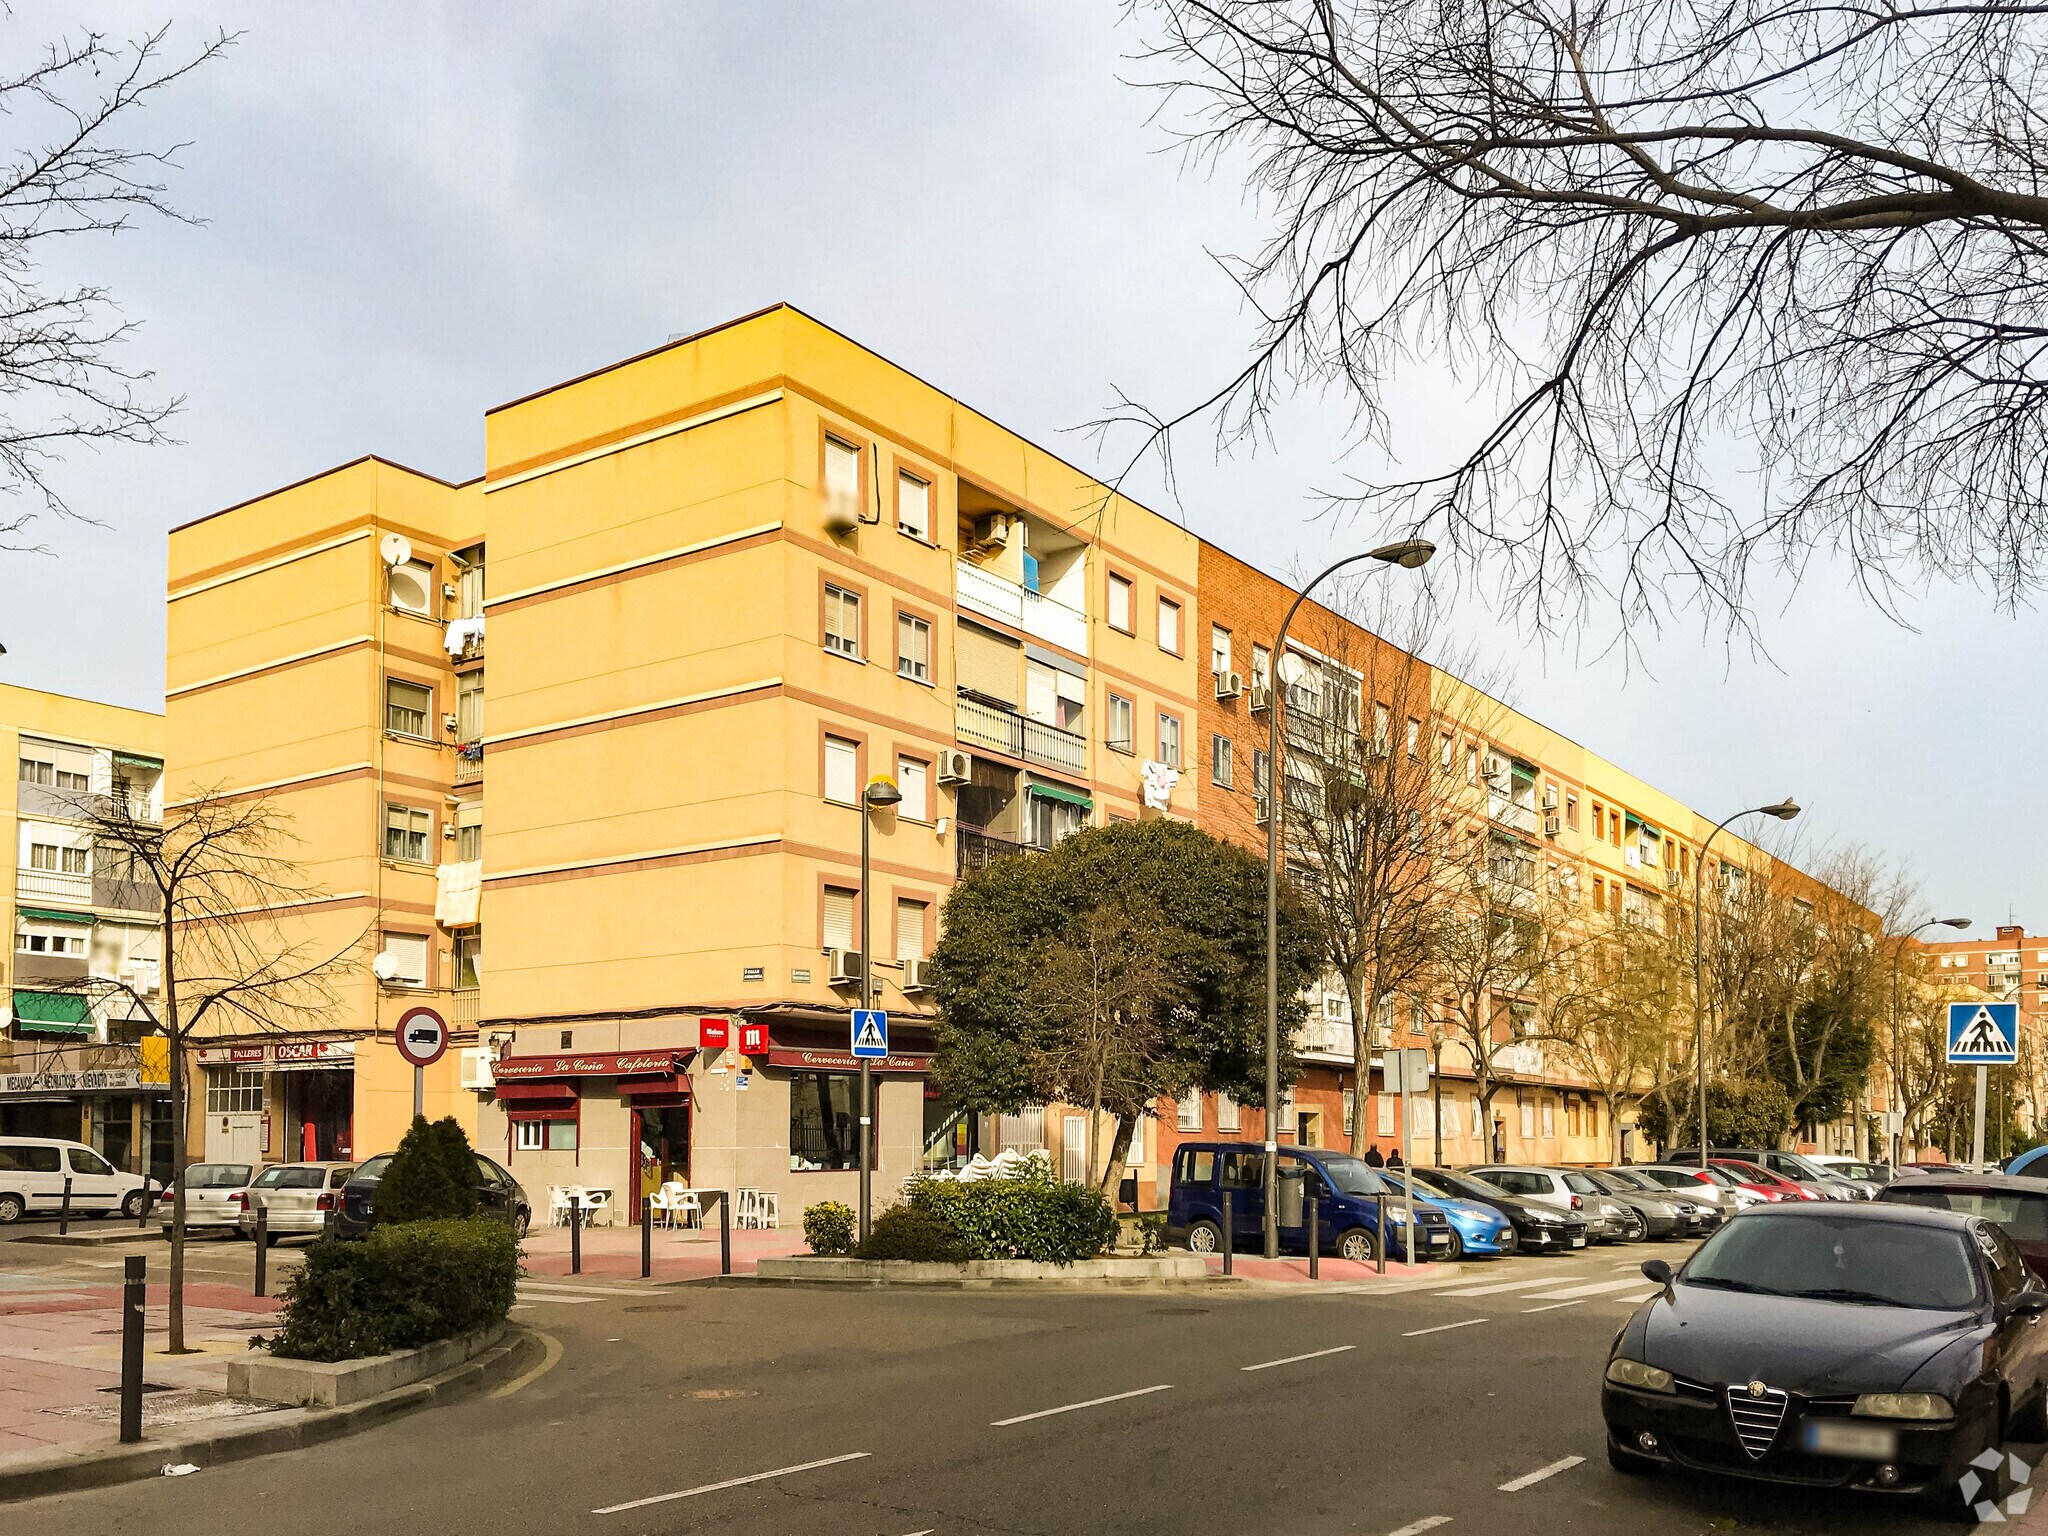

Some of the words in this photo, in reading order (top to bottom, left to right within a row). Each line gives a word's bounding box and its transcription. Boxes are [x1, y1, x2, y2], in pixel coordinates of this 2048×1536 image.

[233, 1049, 262, 1058] TALLERES
[278, 1045, 313, 1058] OSCAR
[491, 1062, 544, 1074] Cervecería
[553, 1060, 571, 1072] La
[572, 1061, 606, 1071] Caña
[616, 1057, 671, 1074] Cafetería
[801, 1052, 859, 1067] Cervecería
[886, 1057, 916, 1068] Caña
